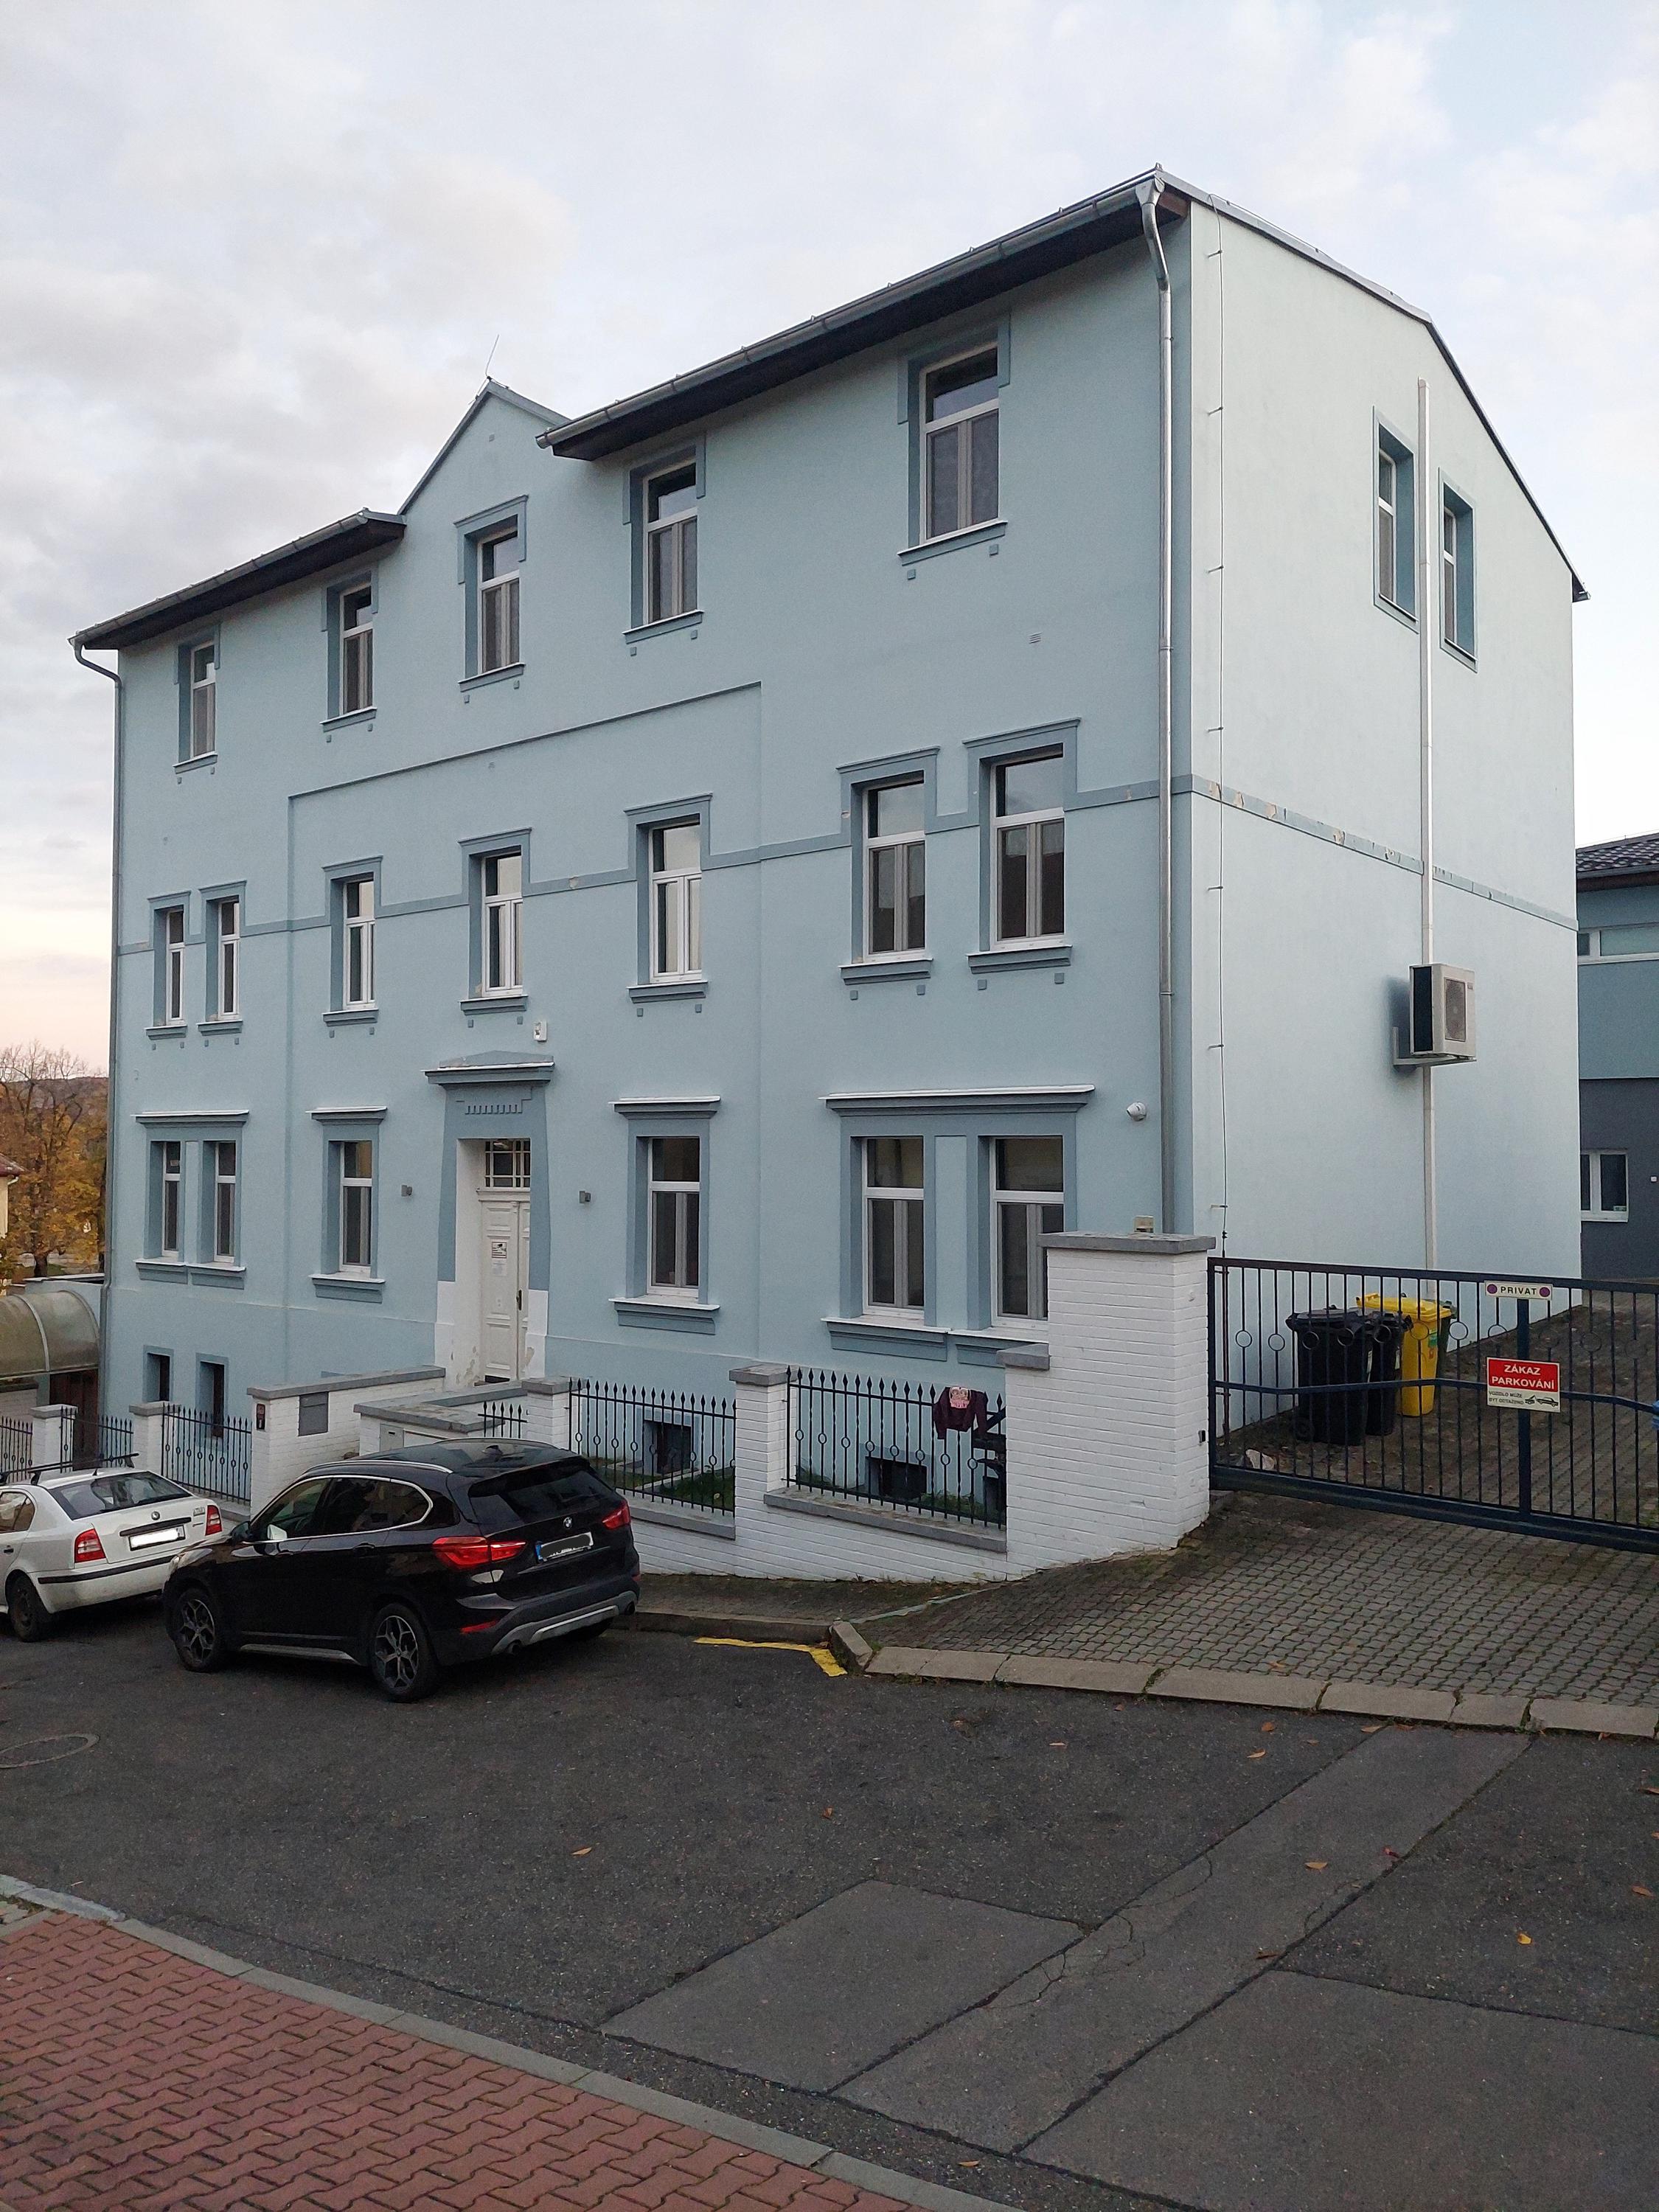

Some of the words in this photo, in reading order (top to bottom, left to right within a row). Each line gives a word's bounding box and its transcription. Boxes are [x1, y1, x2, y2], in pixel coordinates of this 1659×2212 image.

[1500, 1286, 1537, 1295] PRIVAT
[1504, 1364, 1541, 1376] ZÁKAZ
[1492, 1376, 1554, 1390] PARKOVÁNÍ
